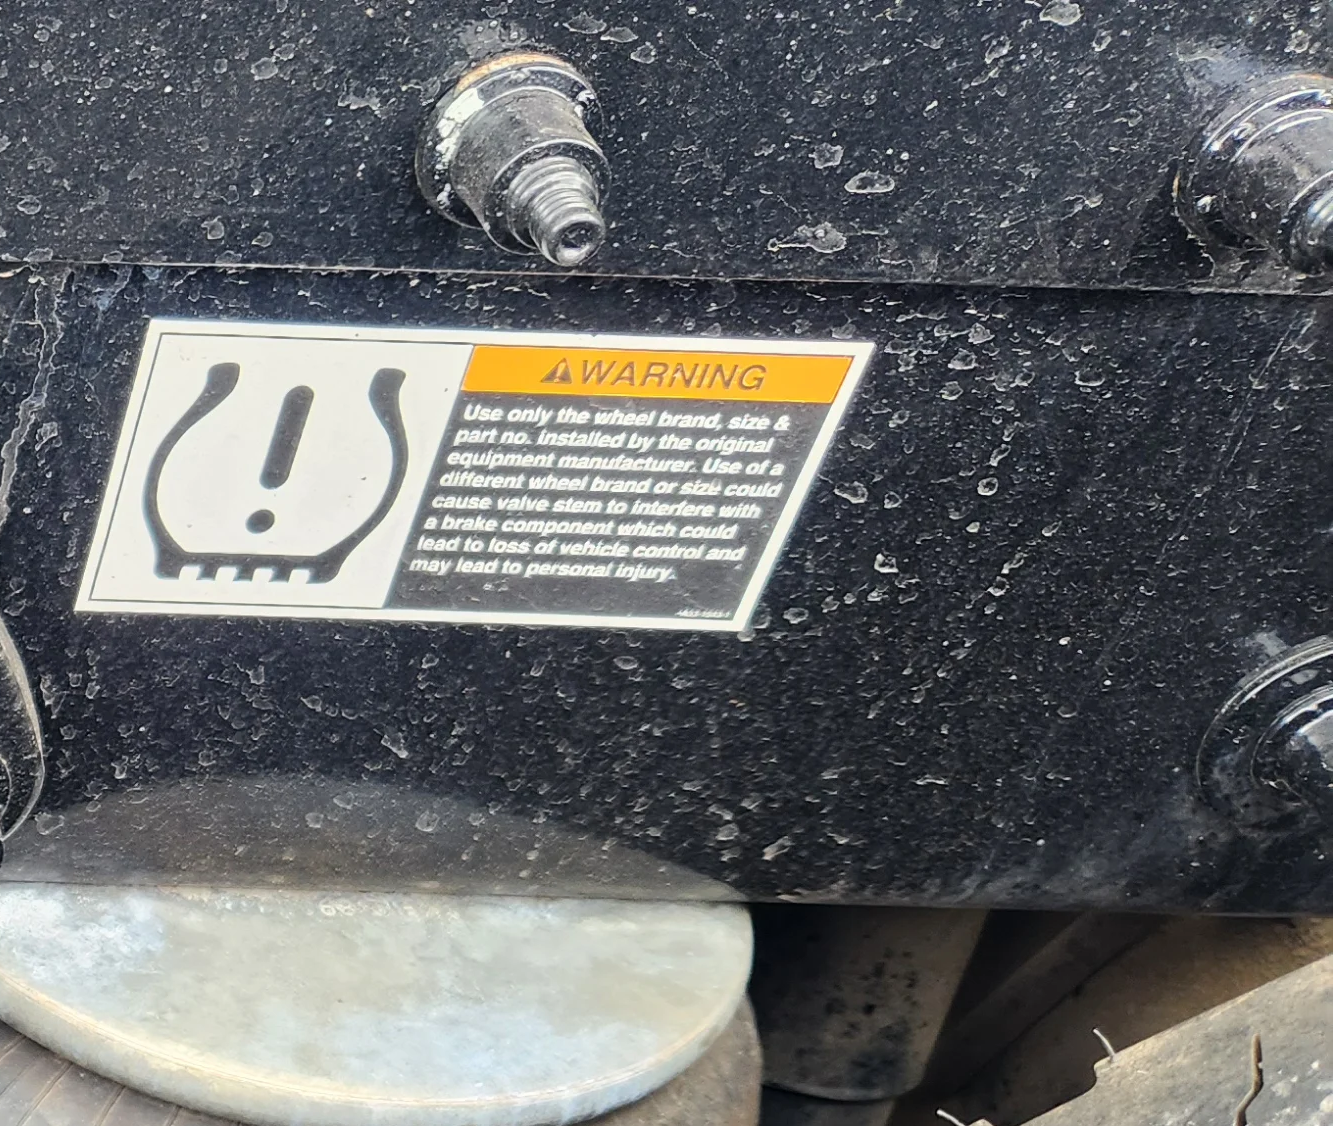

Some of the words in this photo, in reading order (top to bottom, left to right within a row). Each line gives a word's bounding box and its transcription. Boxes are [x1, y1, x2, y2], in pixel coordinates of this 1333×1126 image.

[582, 360, 767, 391] WARNING
[463, 402, 504, 422] Use
[507, 404, 554, 428] only
[556, 405, 591, 424] the
[594, 408, 656, 427] wheel
[657, 410, 722, 431] brand,
[727, 413, 770, 430] size
[773, 415, 791, 431] &
[452, 428, 498, 447] part
[500, 430, 533, 445] no.
[536, 428, 627, 448] installed
[627, 432, 655, 453] by
[658, 434, 693, 451] the
[695, 435, 775, 455] original
[446, 450, 556, 470] equipment
[557, 453, 697, 474] manufacturer.
[702, 457, 743, 475] Use
[746, 459, 771, 476] of
[769, 463, 785, 476] a
[439, 470, 526, 489] different
[527, 473, 589, 491] wheel
[590, 475, 654, 494] brand
[653, 480, 678, 494] or
[678, 479, 722, 495] size
[724, 481, 784, 498] could
[432, 494, 493, 509] cause
[497, 492, 550, 511] valve
[552, 497, 603, 513] stem
[605, 498, 628, 514] to
[630, 498, 715, 517] interfere
[717, 502, 763, 519] with
[423, 516, 438, 530] a
[440, 513, 498, 532] brake
[501, 517, 615, 537] component
[617, 520, 677, 537] which
[679, 523, 739, 539] could
[416, 534, 462, 551] lead
[463, 536, 485, 552] to
[487, 535, 532, 554] loss
[533, 538, 559, 555] of
[560, 538, 630, 557] vehicle
[632, 543, 706, 559] control
[704, 544, 748, 561] and
[409, 558, 452, 576] may
[453, 556, 500, 574] lead
[501, 558, 523, 575] to
[523, 560, 613, 578] personal
[614, 561, 677, 583] injury.
